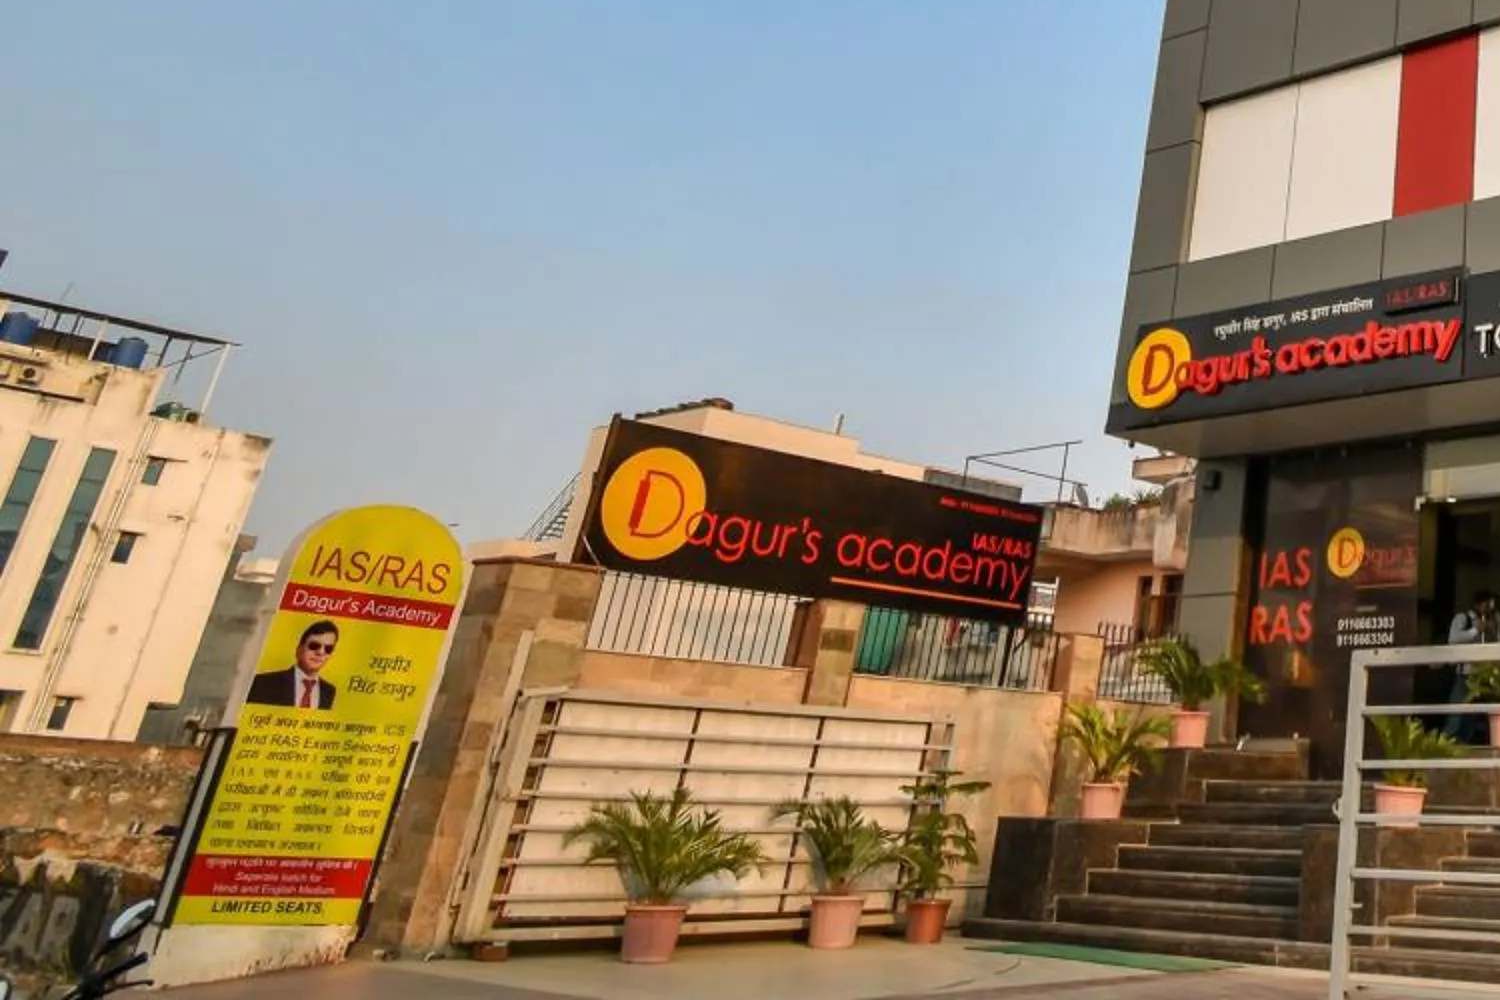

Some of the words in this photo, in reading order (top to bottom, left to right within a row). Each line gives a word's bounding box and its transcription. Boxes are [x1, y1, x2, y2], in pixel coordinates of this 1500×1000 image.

[1142, 335, 1273, 396] Dagur's
[1275, 319, 1463, 375] academy
[627, 467, 822, 563] Dagur's
[836, 532, 1030, 600] academy
[972, 532, 1032, 559] IAS/RAS
[309, 545, 450, 595] IAS/RAS
[1259, 547, 1312, 590] IAS
[292, 589, 360, 613] Dagur's
[361, 599, 442, 627] Academy
[1250, 600, 1313, 645] RAS
[269, 734, 300, 749] RAS
[211, 899, 273, 914] LIMITED
[275, 901, 323, 915] SEATS
